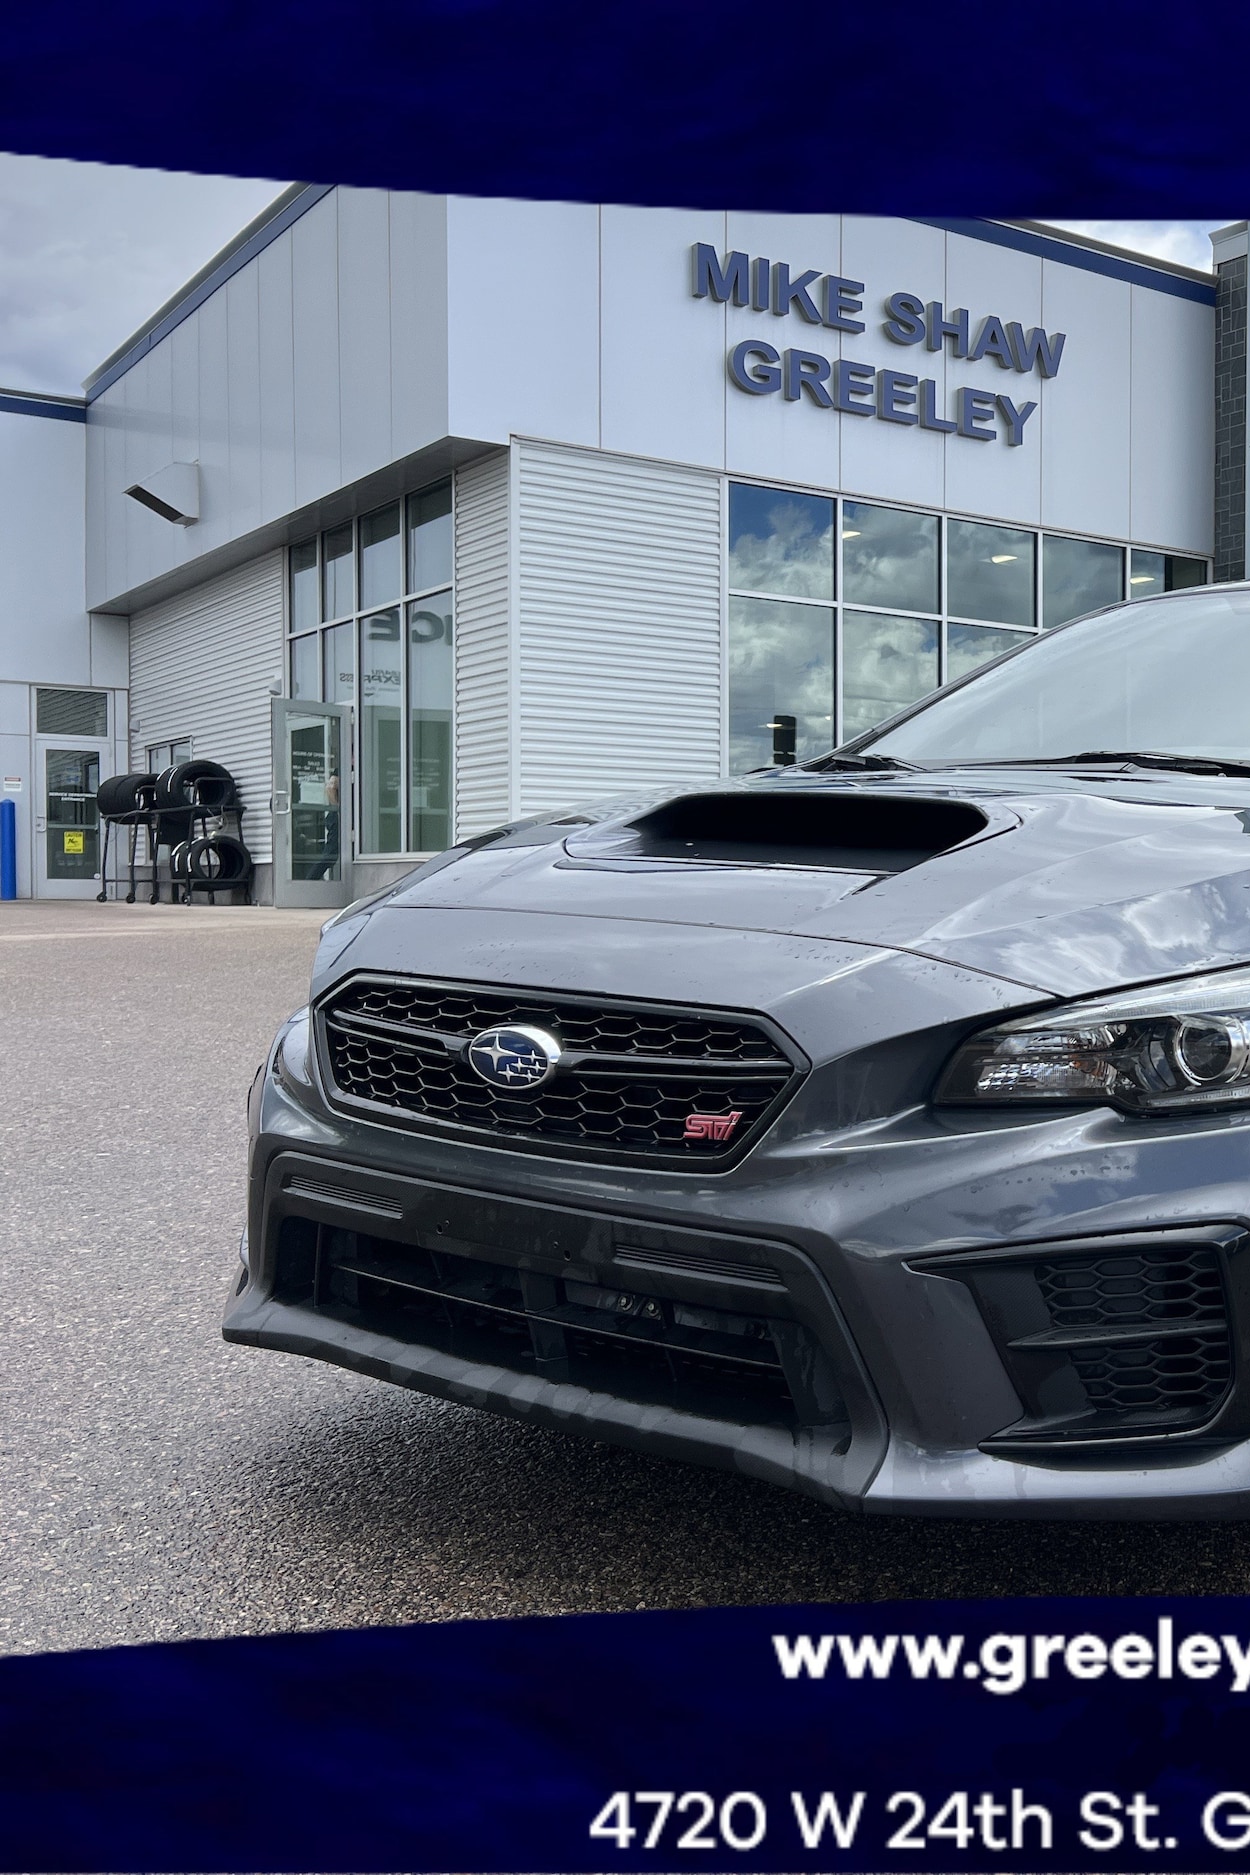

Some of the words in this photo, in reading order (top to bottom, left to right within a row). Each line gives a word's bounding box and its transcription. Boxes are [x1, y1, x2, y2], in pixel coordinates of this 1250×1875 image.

[692, 242, 865, 333] MIKE
[883, 292, 1066, 378] SHAW
[727, 340, 1038, 446] GREELEY
